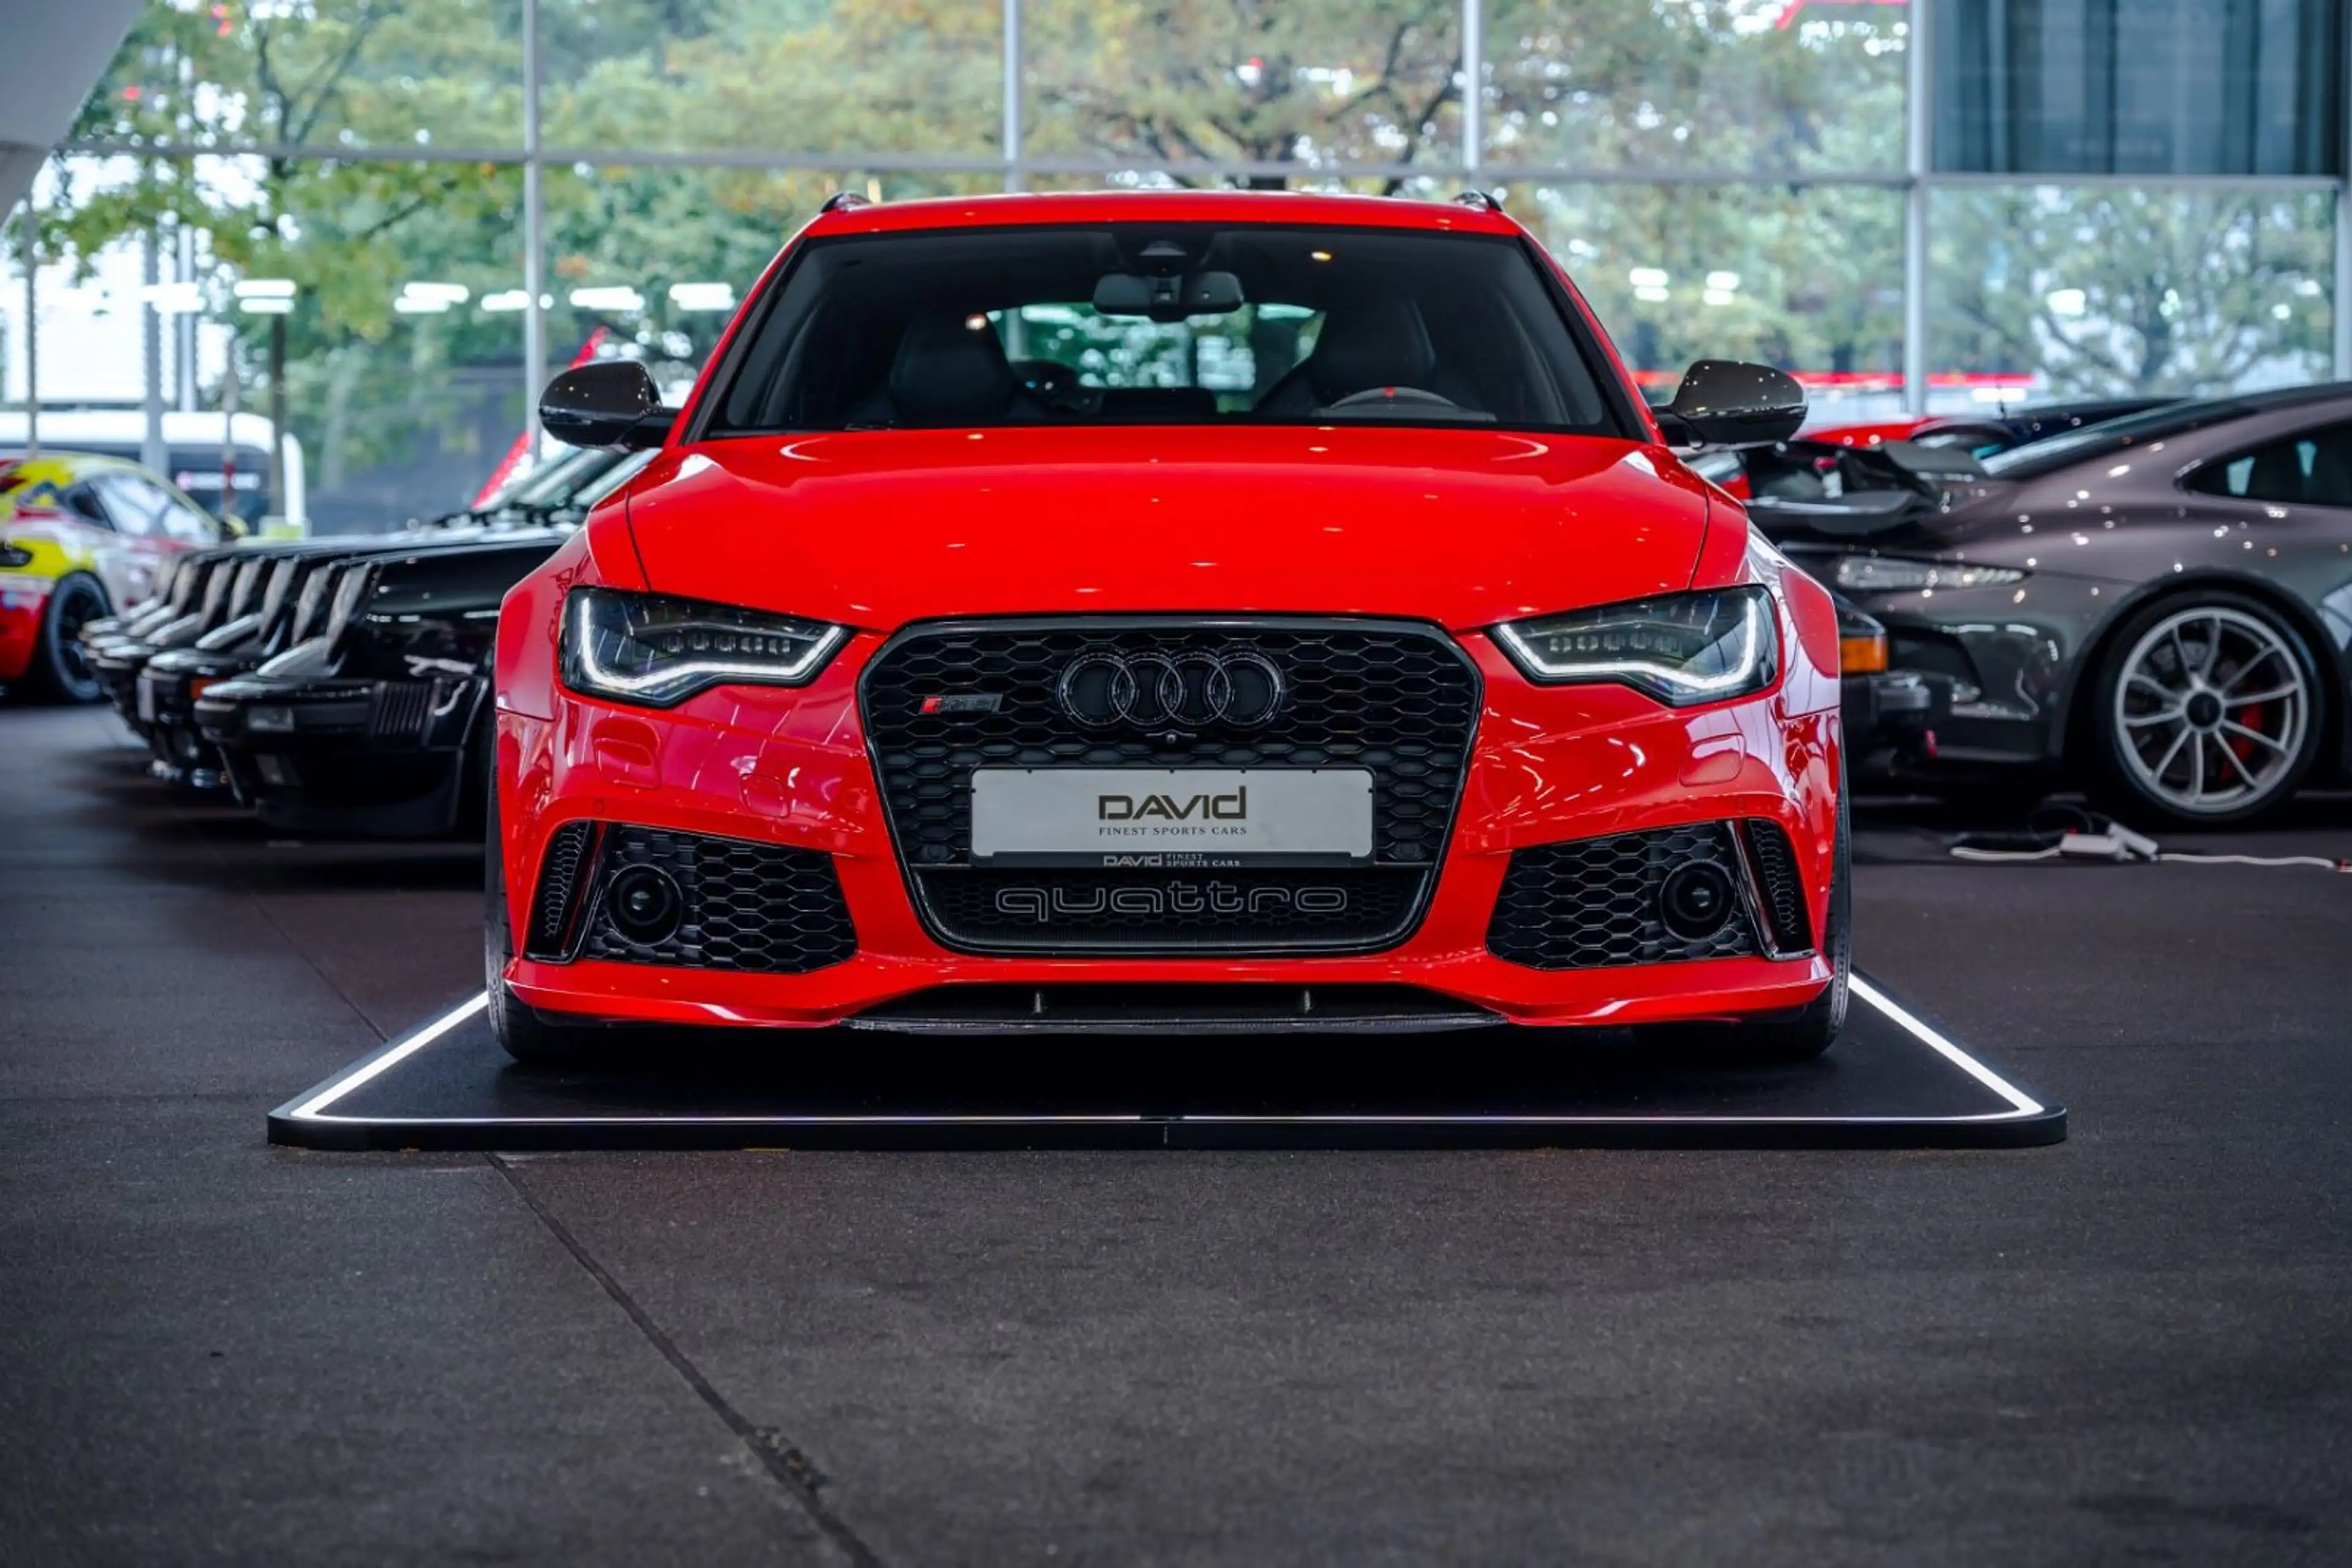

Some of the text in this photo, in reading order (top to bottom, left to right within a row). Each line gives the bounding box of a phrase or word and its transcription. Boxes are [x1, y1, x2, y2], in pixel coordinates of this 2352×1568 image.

[1099, 827, 1247, 836] FINEST SPORTS CARS
[995, 881, 1348, 922] quattro
